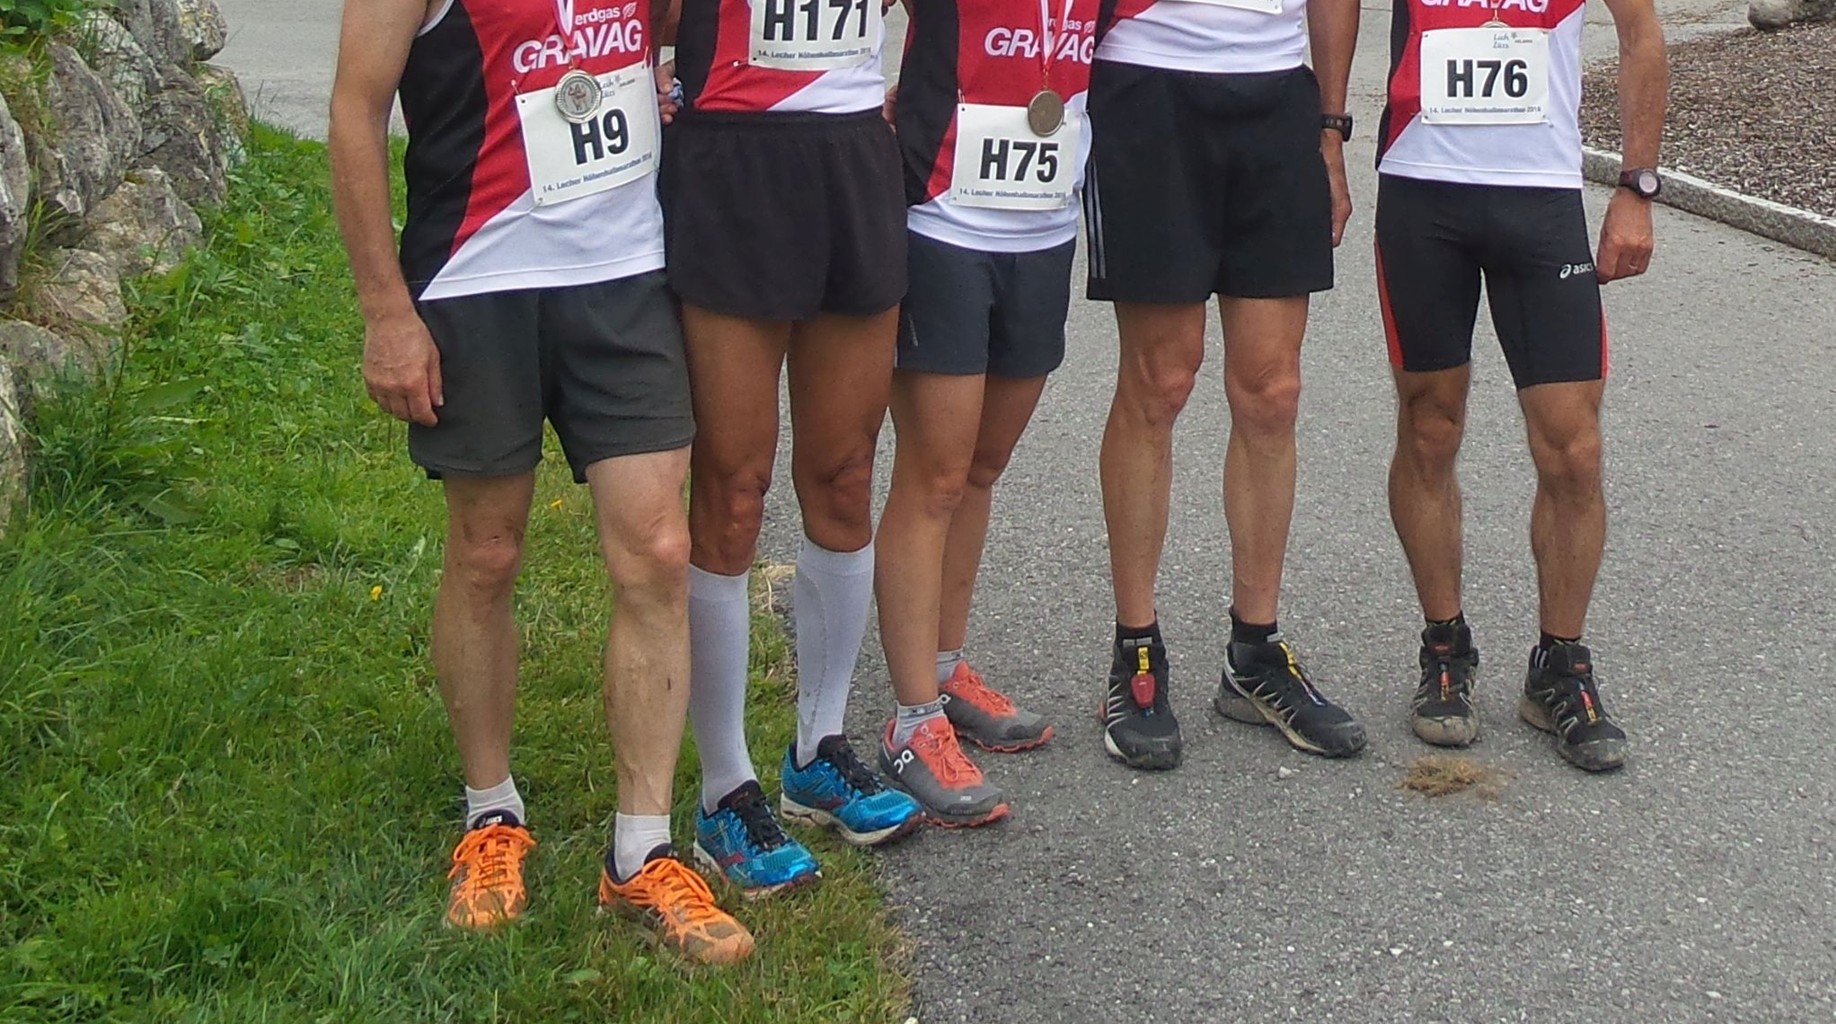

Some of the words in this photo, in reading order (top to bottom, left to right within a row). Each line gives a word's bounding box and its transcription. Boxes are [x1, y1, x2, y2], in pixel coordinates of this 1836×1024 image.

[575, 6, 621, 26] erdgas
[513, 19, 643, 74] GRAVAG
[1447, 59, 1529, 98] H76
[570, 108, 630, 166] H9
[980, 138, 1059, 183] H75
